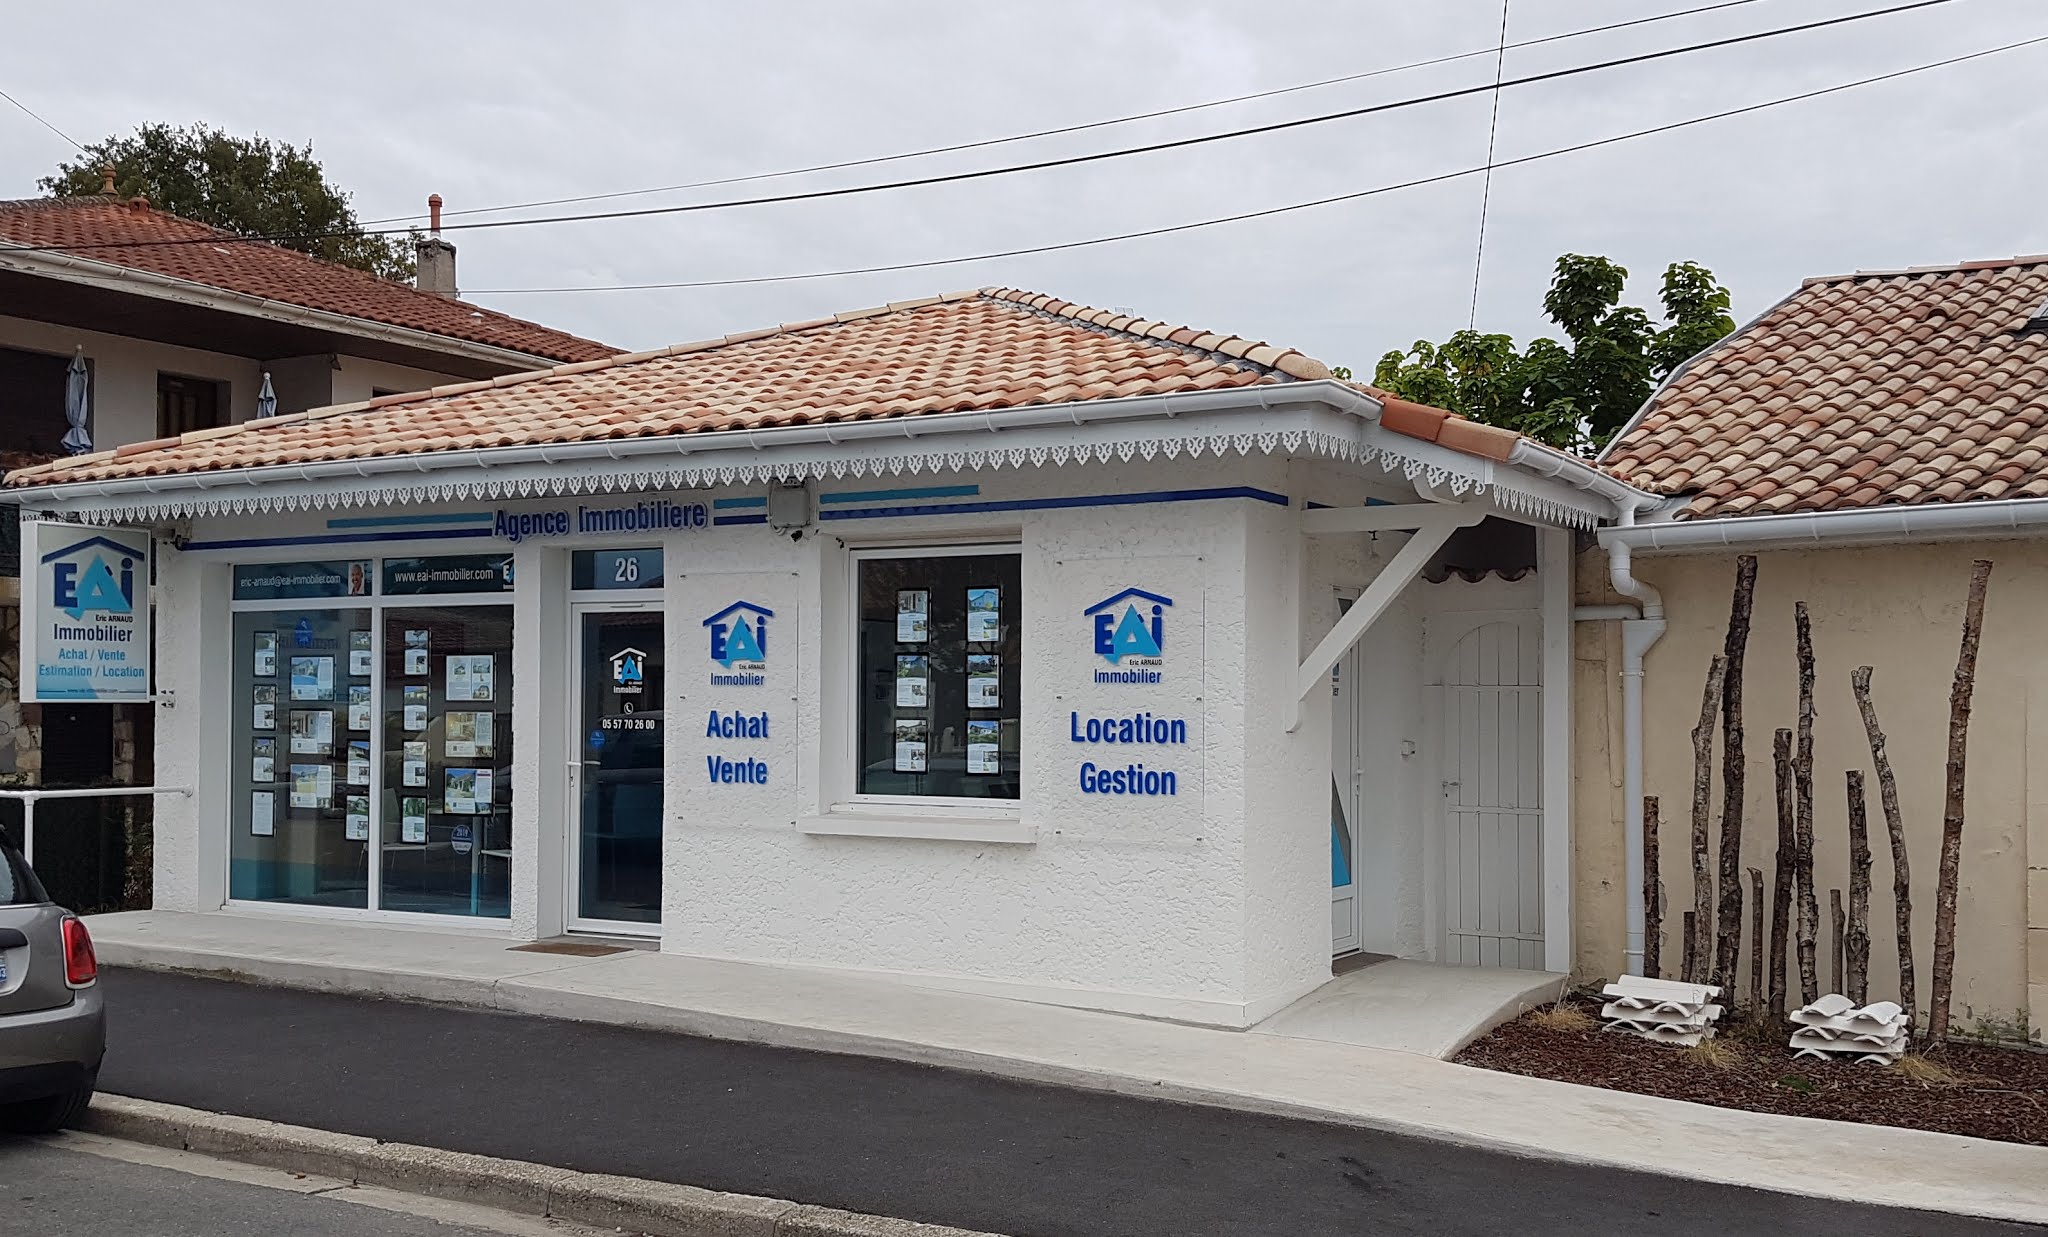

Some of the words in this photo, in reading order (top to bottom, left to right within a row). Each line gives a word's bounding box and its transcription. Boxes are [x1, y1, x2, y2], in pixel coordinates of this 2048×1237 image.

[494, 510, 570, 542] Agence
[395, 568, 494, 583] www.eai-immobilier.com
[615, 557, 638, 582] 26
[108, 615, 134, 624] ARNAUD
[53, 623, 133, 642] Immobilier
[58, 648, 88, 660] Achat
[97, 649, 126, 661] Vente
[39, 664, 92, 677] Estimation
[103, 665, 145, 678] Location
[710, 672, 765, 686] Immobilier
[1094, 668, 1162, 684] Immobilier
[613, 685, 642, 693] Immobilier
[602, 719, 612, 729] 05
[613, 719, 622, 729] 57
[624, 719, 633, 729] 70
[635, 719, 644, 729] 26
[645, 719, 655, 729] 00
[706, 710, 769, 738] Achat
[1071, 711, 1186, 744] Location
[706, 755, 768, 784] Vente
[1080, 762, 1176, 795] Gestion
